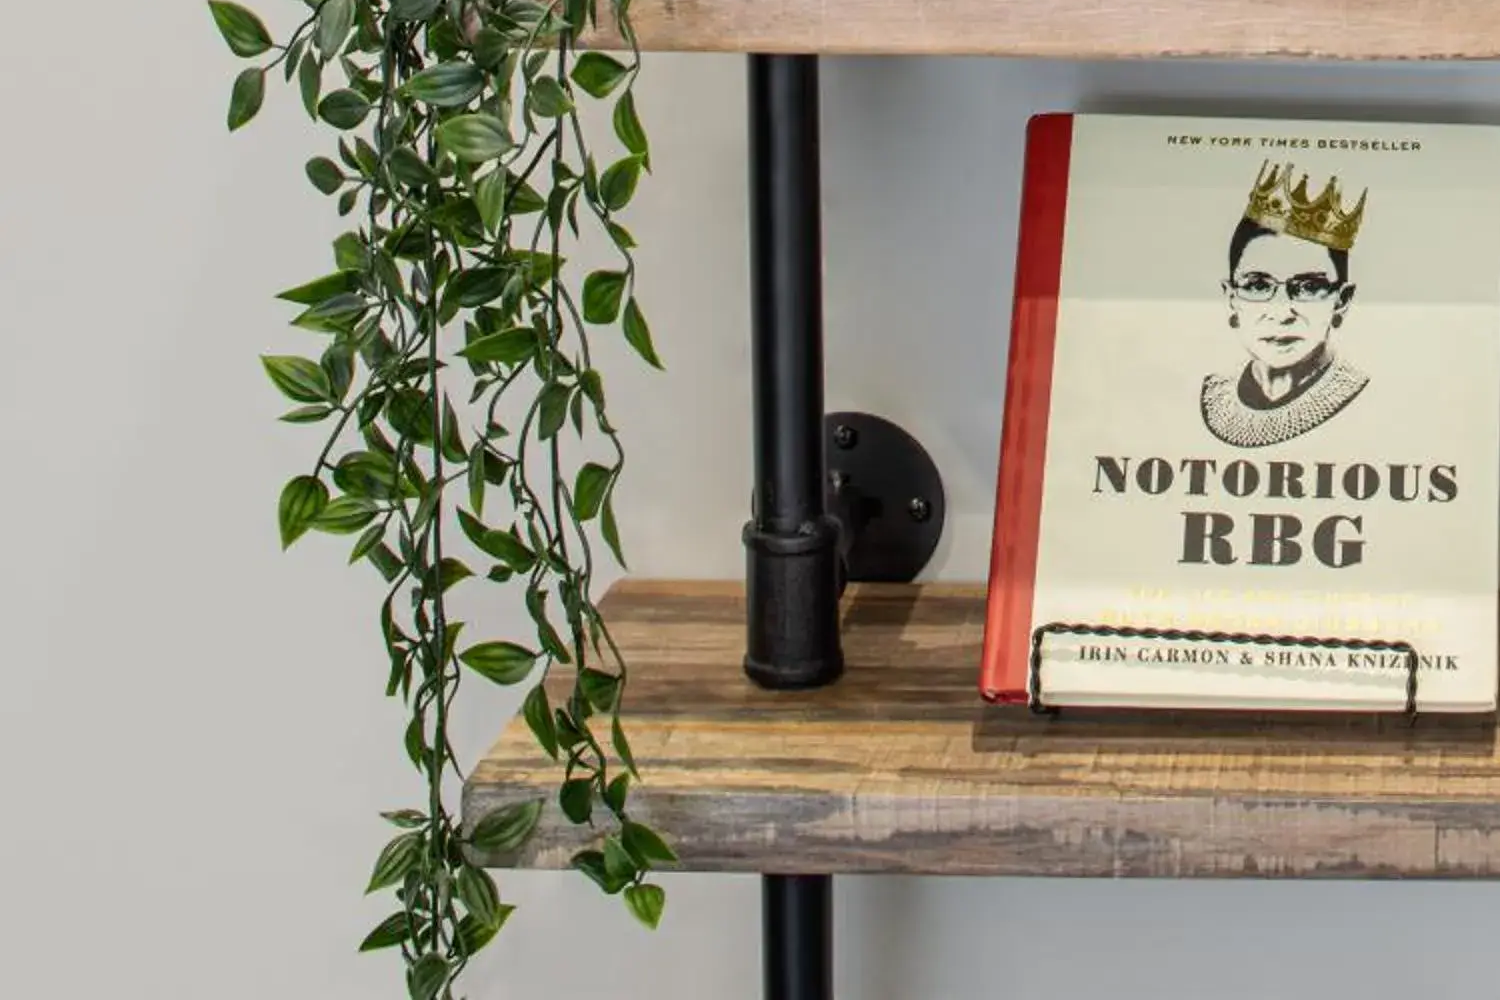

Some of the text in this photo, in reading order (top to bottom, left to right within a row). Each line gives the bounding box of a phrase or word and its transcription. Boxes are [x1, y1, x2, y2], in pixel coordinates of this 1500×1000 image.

[1167, 135, 1422, 151] NEW YORK TIMES BESTSELLER
[1092, 456, 1459, 503] NOTORIOUS
[1177, 511, 1366, 569] RBG
[1079, 645, 1128, 662] IRIN
[1137, 647, 1230, 665] CARMON
[1240, 651, 1254, 665] &
[1264, 651, 1337, 668] SHANA
